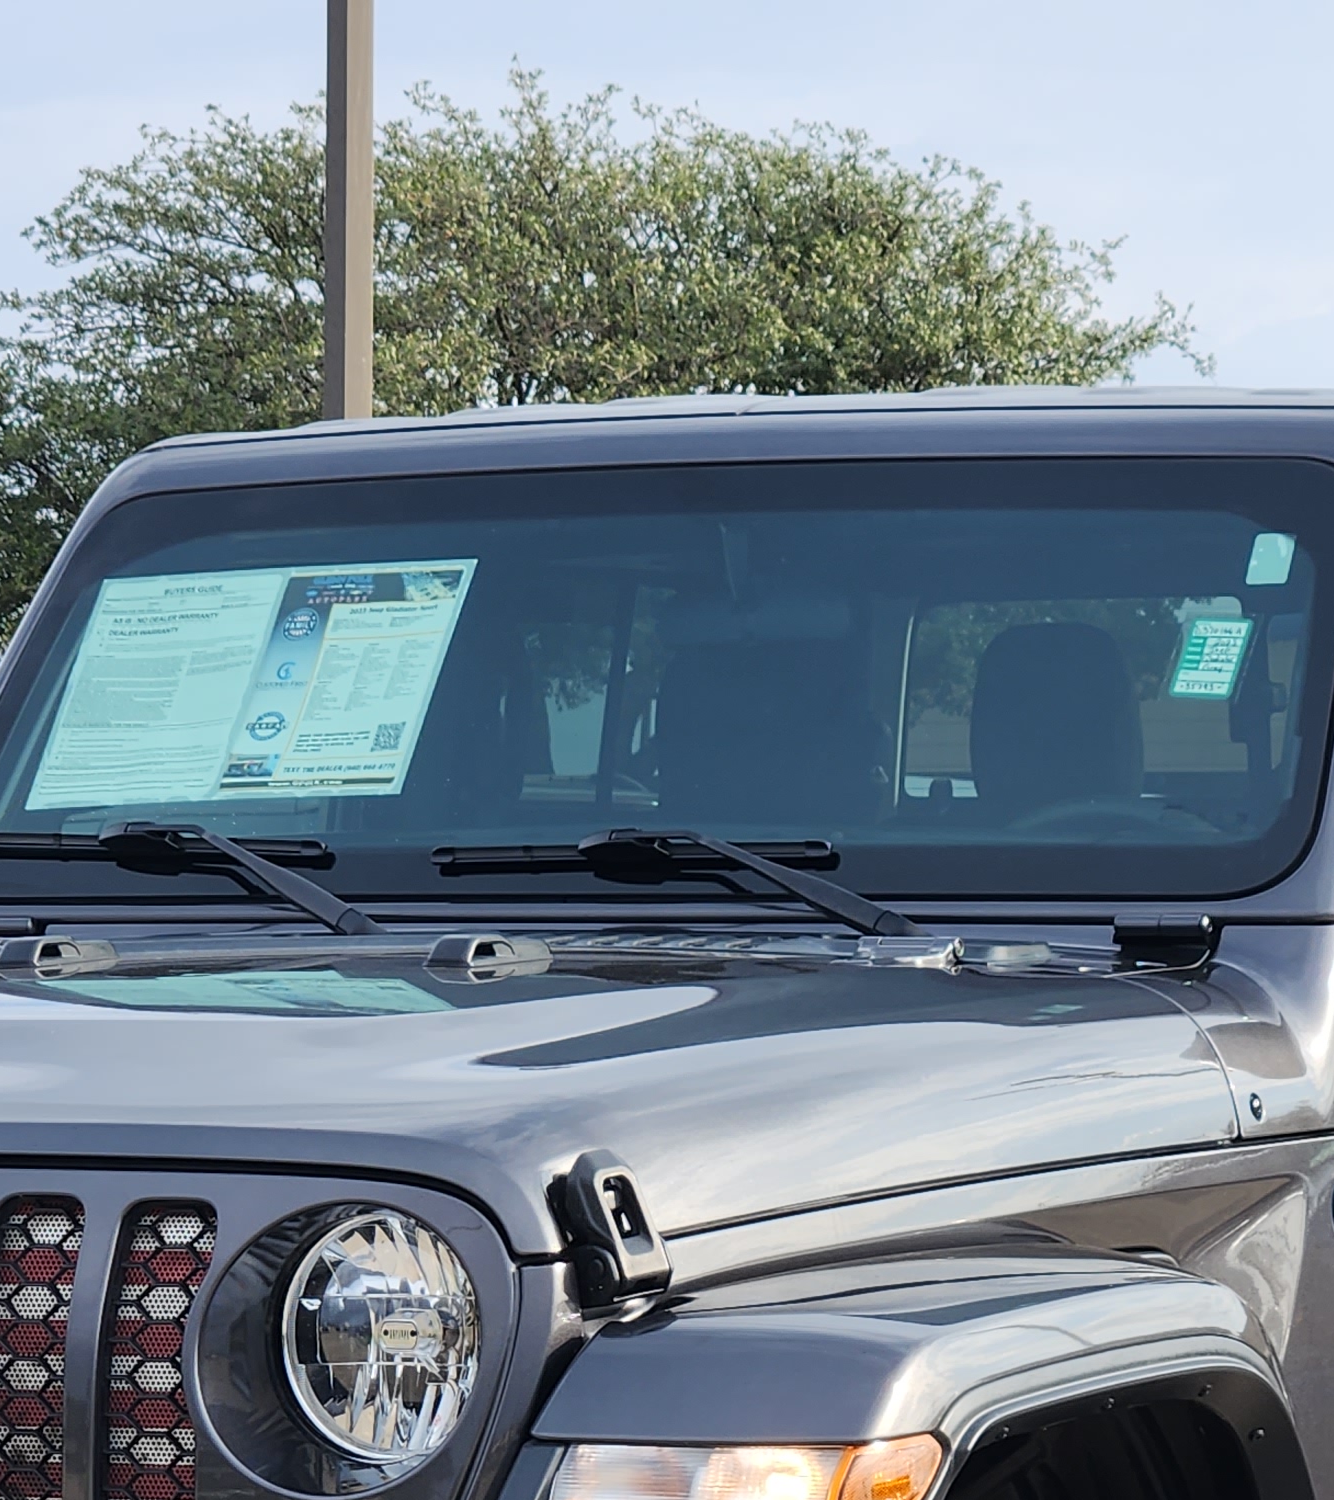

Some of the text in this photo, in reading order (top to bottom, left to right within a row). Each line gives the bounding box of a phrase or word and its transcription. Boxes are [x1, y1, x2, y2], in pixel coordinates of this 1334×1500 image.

[164, 584, 224, 596] BUYERS GUIDE
[151, 614, 177, 623] DEALER
[177, 612, 219, 621] WARRANTY
[108, 627, 179, 637] DEALER WARRANTY
